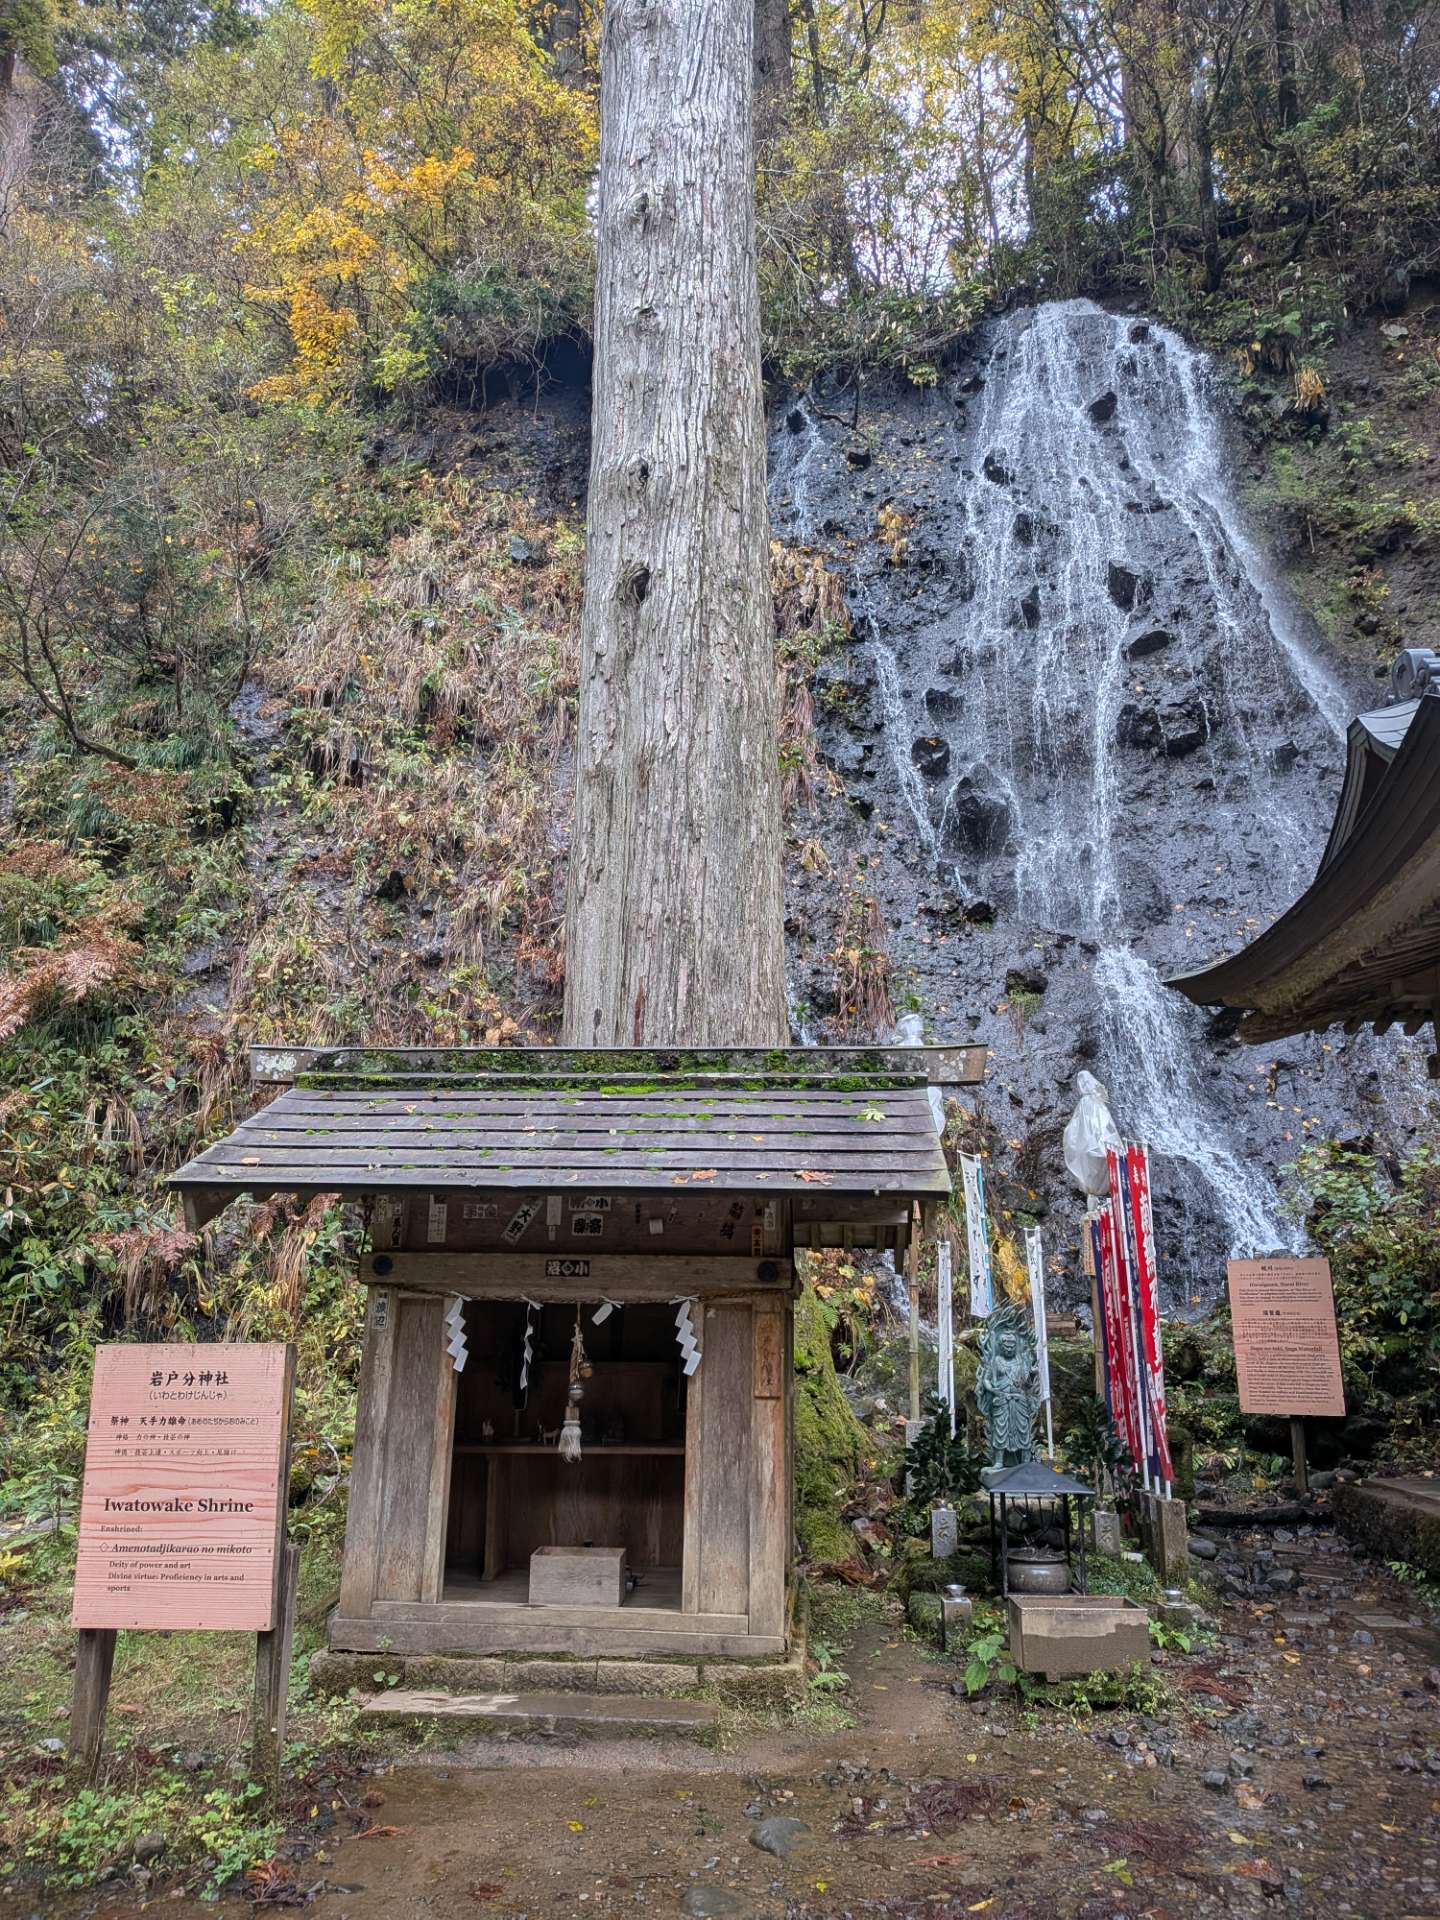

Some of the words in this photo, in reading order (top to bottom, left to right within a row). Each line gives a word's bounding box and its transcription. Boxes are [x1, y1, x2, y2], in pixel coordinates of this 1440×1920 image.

[148, 1370, 230, 1387] 岩戸分神社
[104, 1497, 193, 1513] Iwatowake
[197, 1497, 254, 1513] Shrine
